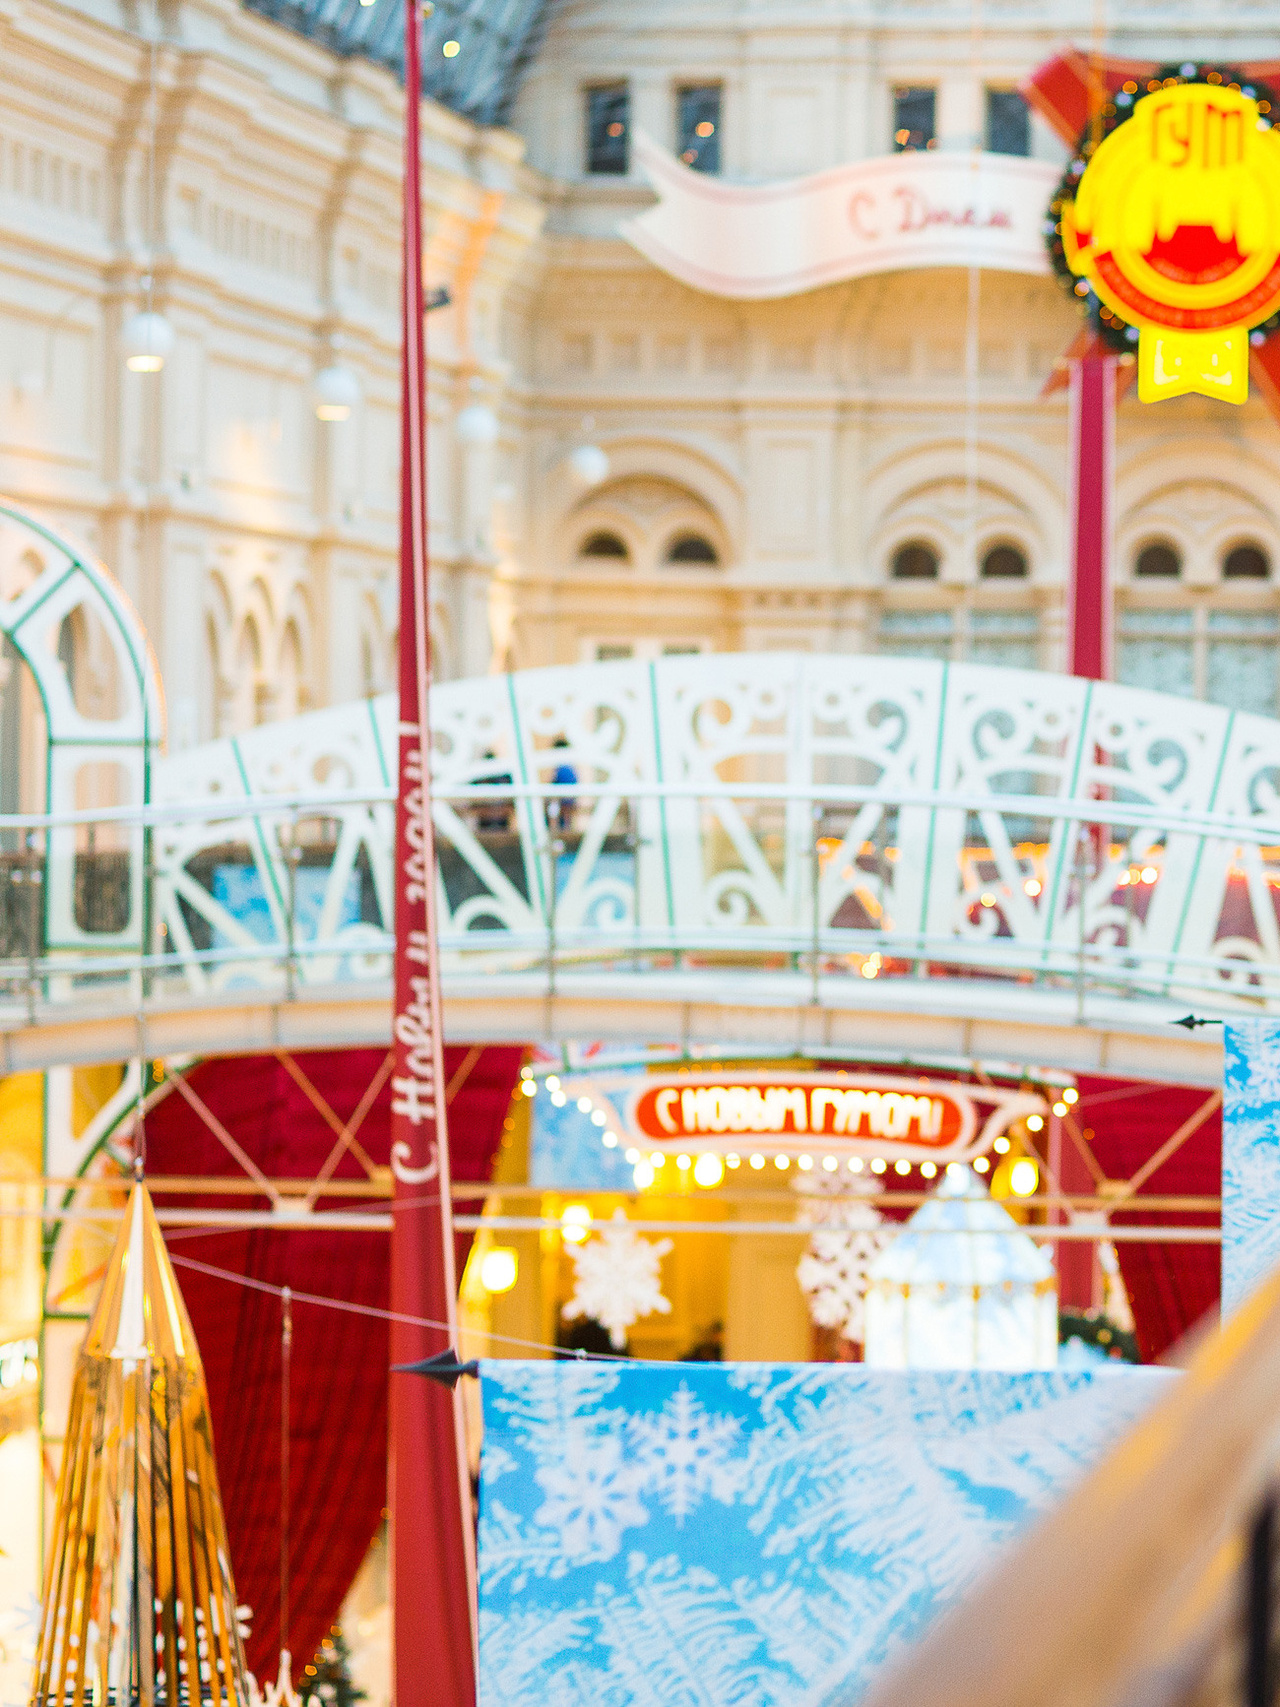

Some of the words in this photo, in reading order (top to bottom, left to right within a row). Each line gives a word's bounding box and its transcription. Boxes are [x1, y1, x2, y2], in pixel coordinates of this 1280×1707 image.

[1151, 101, 1245, 168] ГУМ
[847, 191, 878, 241] С
[655, 1088, 679, 1133] С
[681, 1087, 807, 1132] НОВЫМ
[391, 1140, 439, 1184] С
